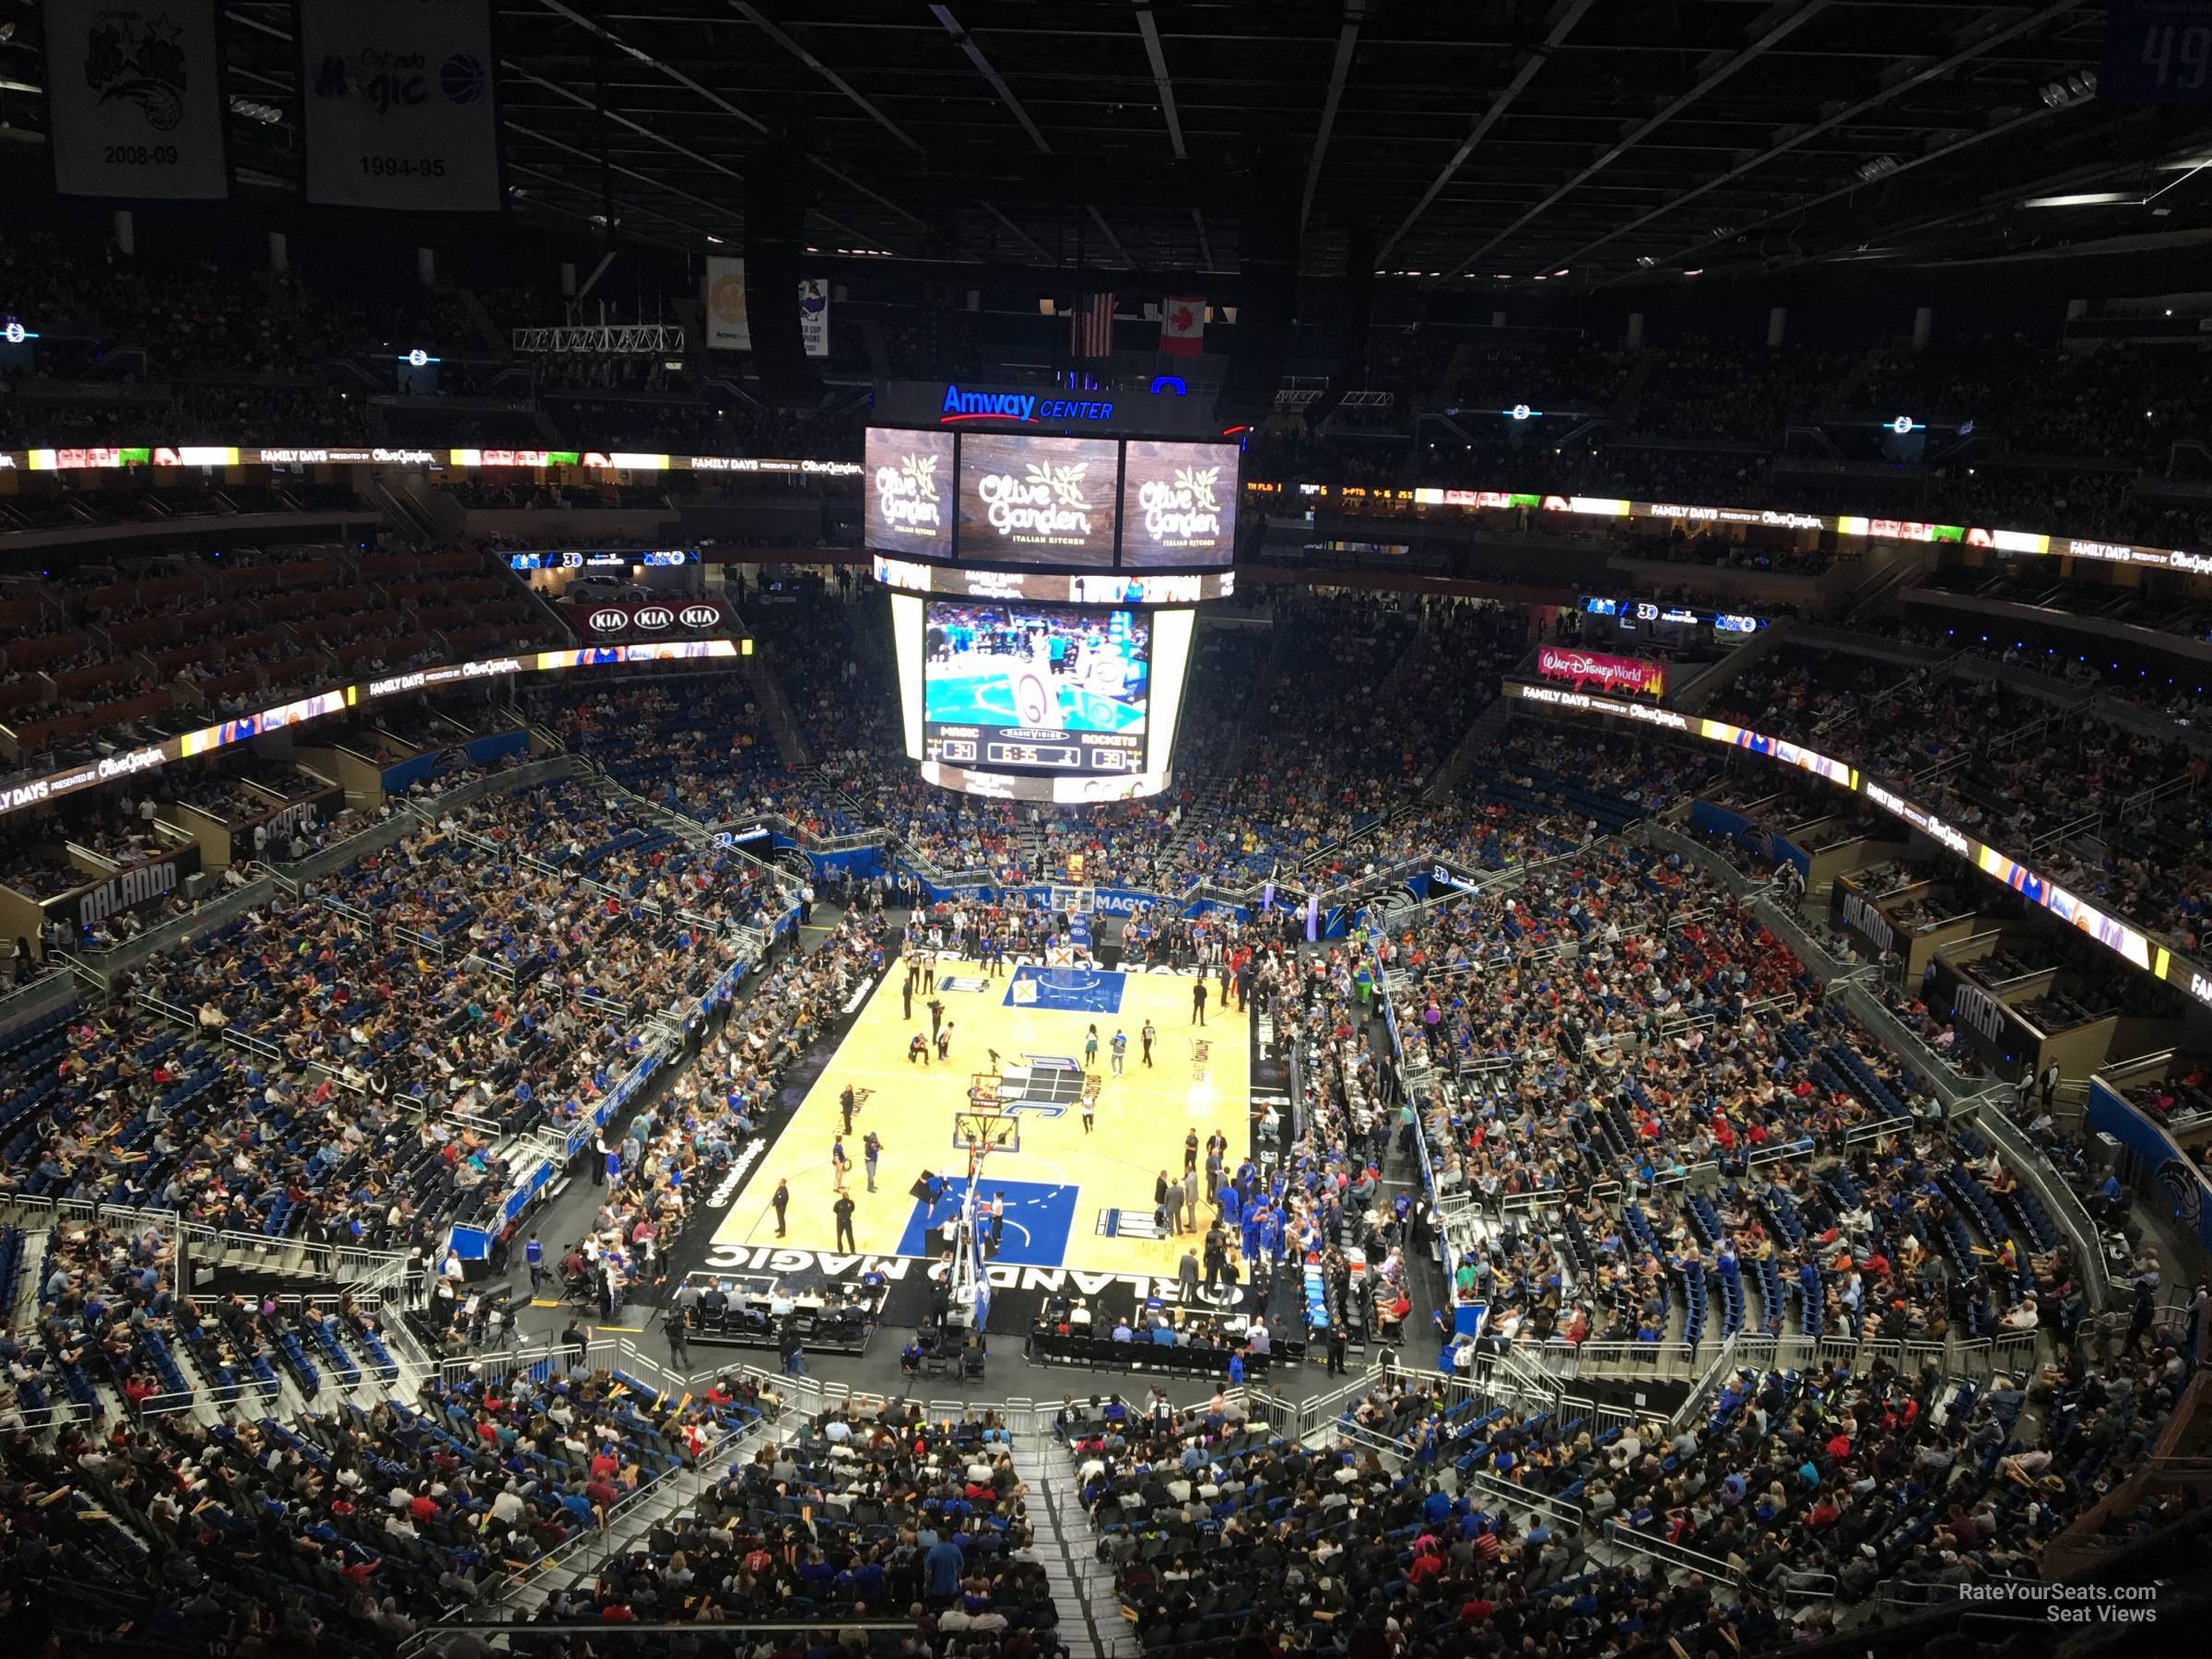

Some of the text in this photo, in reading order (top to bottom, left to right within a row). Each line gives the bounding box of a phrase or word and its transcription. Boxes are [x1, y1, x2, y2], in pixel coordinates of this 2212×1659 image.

[360, 157, 445, 177] 1994-95
[943, 383, 1113, 421] Amway CENTER
[261, 450, 298, 462] FAMILY
[299, 450, 327, 462] DAYS
[691, 457, 729, 469] FAMILY
[731, 459, 758, 470] DAYS
[876, 466, 916, 496] Olive
[979, 474, 1051, 504] Olive
[1139, 481, 1192, 510] Olive
[881, 494, 940, 525] Garden
[988, 500, 1092, 535] Garden
[1652, 504, 1688, 518] FAMILY
[1689, 507, 1718, 519] DAYS
[1146, 506, 1219, 540] Garden
[1013, 535, 1085, 546] ITALIAN KITCHEN
[2070, 541, 2106, 558] FAMILY
[2105, 547, 2131, 560] DAYS
[596, 613, 621, 628] KIA
[641, 610, 666, 626] KIA
[689, 609, 712, 625] KIA
[1613, 665, 1641, 682] World
[370, 677, 401, 696] FAMILY
[402, 673, 424, 688] DAYS
[1523, 687, 1560, 701] FAMILY
[1561, 692, 1590, 708] DAYS
[1081, 734, 1136, 747] ROCKETS
[1003, 747, 1037, 761] 6:35
[13, 781, 49, 806] DAYS
[52, 772, 86, 792] PRESENTED
[87, 771, 95, 782] BY
[79, 861, 177, 925] ORLANDO
[1096, 894, 1150, 912] MAGIC
[1844, 892, 1894, 953] ORLANDO
[1954, 983, 2006, 1043] MAGIC
[705, 1245, 911, 1280] MAGIC
[1160, 1407, 1170, 1418] 10
[207, 1641, 227, 1656] 10
